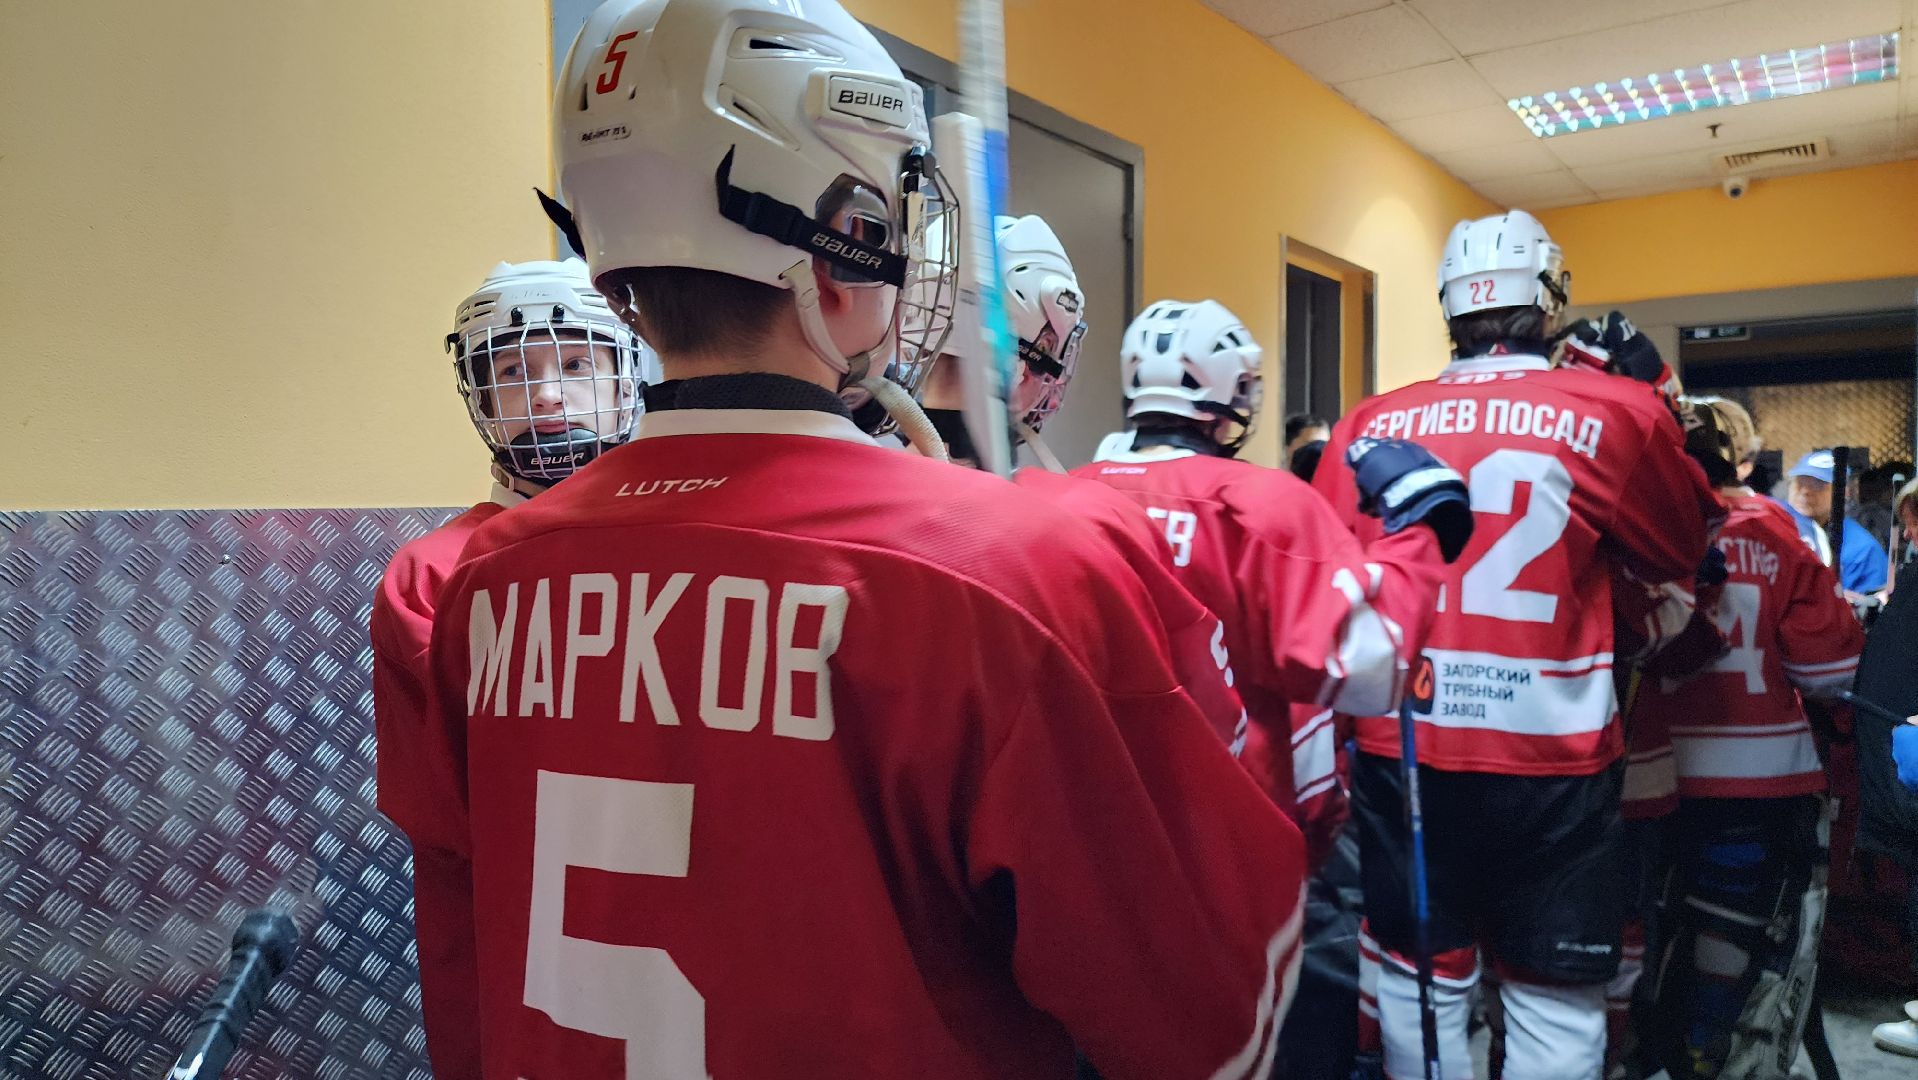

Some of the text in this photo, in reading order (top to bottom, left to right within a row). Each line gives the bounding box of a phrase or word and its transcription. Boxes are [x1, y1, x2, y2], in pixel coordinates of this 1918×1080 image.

[595, 31, 639, 95] 5
[838, 90, 903, 112] BAUER
[812, 232, 883, 269] BAUER
[1469, 279, 1497, 305] 22
[1484, 399, 1603, 459] ПОСАД
[614, 476, 730, 498] LUTCH
[467, 572, 851, 741] МАРКОВ
[1442, 663, 1531, 686] ЗАГОРСКИЙ
[1442, 702, 1486, 719] ЗАВОД
[522, 769, 714, 1080] 5
